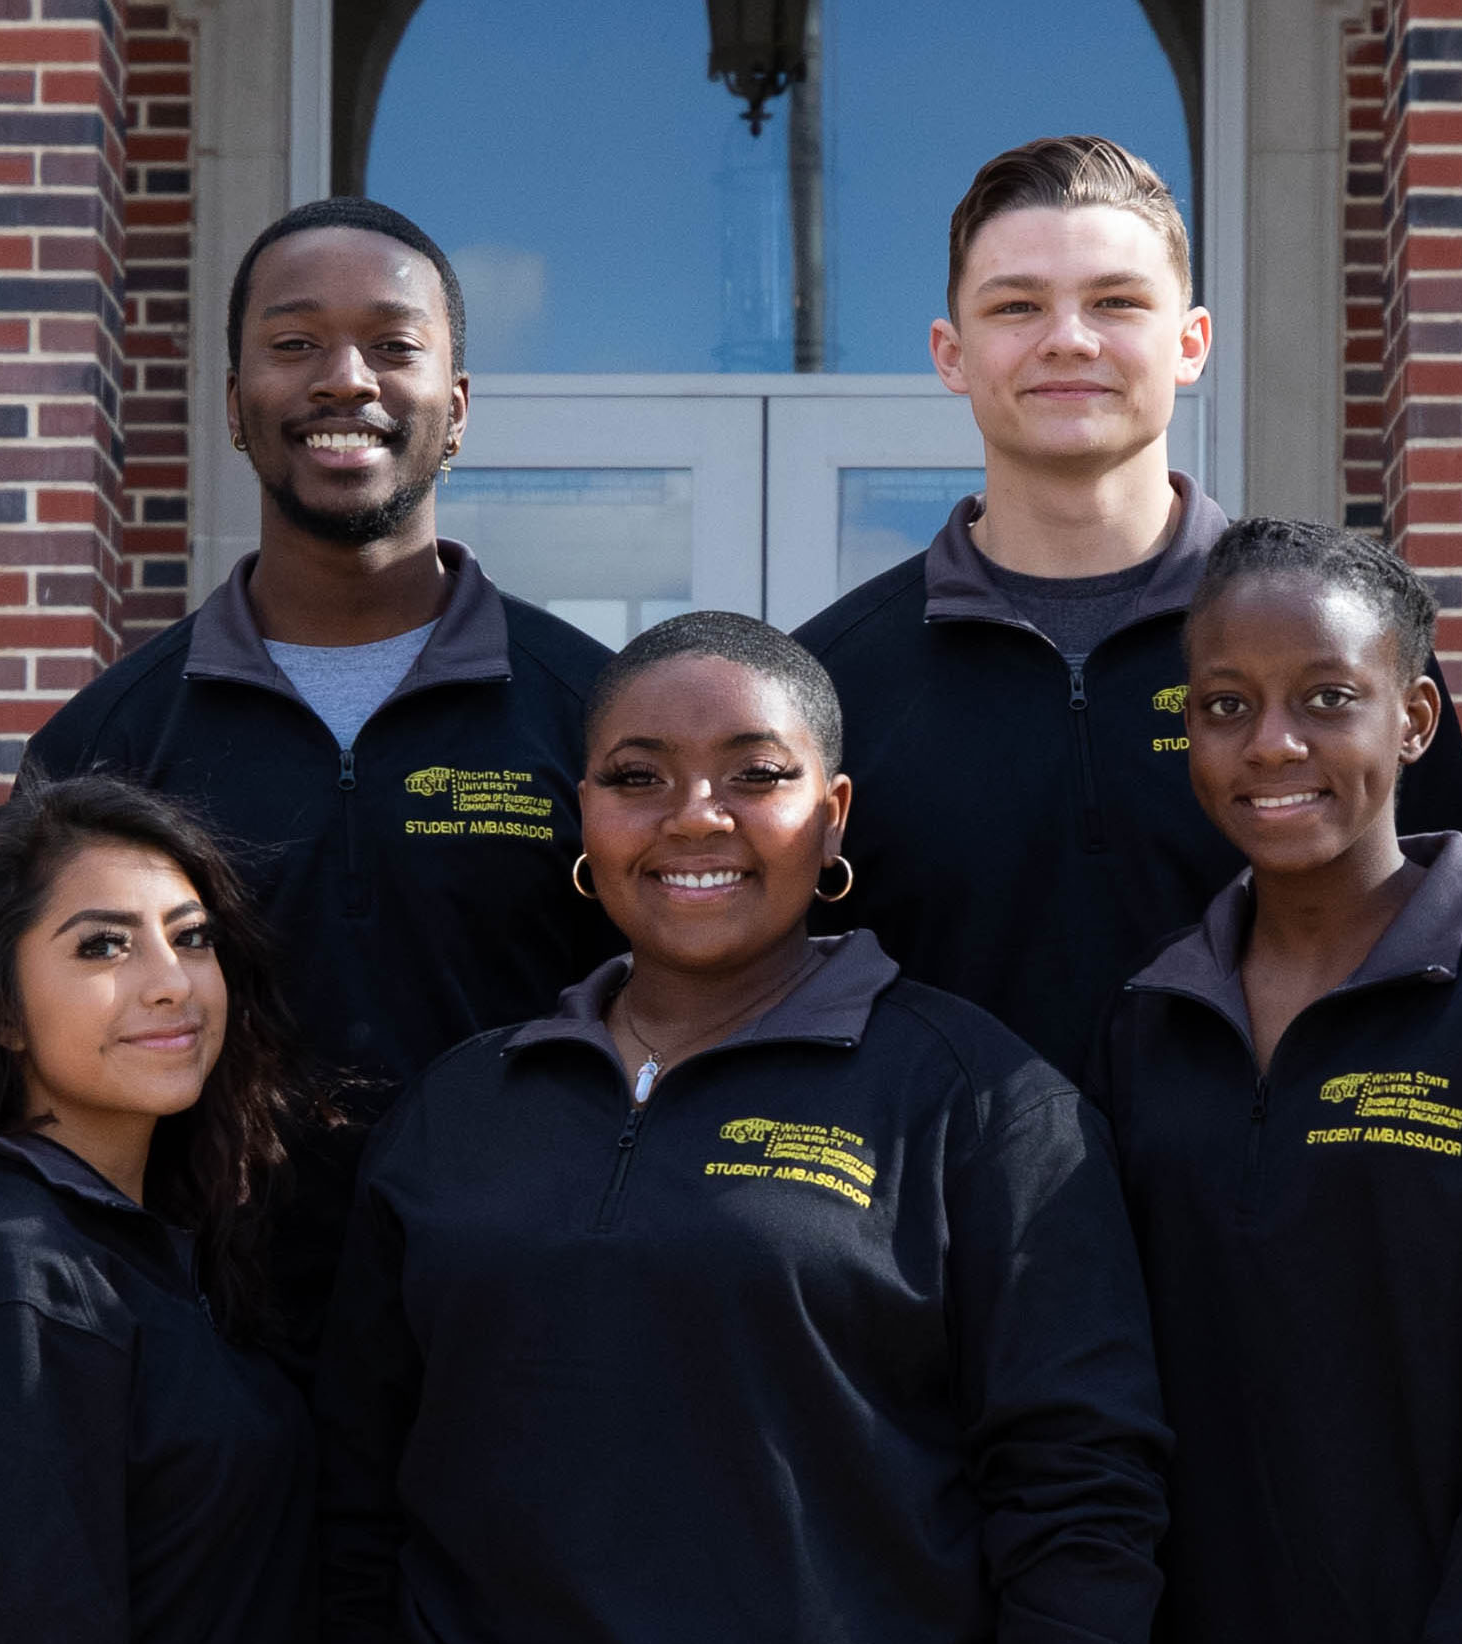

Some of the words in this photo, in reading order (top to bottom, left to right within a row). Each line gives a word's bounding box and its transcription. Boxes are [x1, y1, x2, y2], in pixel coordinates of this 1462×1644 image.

[1153, 738, 1190, 750] STUD
[457, 770, 501, 780] WICHITA
[503, 770, 532, 781] STATE
[457, 780, 518, 791] UNIVERSITY
[405, 820, 466, 833] STUDENT
[469, 820, 554, 839] AMBASSADOR
[1416, 1071, 1450, 1087] STATE
[1368, 1083, 1429, 1095] UNIVERSITY
[777, 1132, 844, 1147] UNIVERSITY
[780, 1122, 827, 1134] WICHITA
[831, 1126, 864, 1145] STATE
[1307, 1128, 1363, 1143] STUDENT
[1364, 1127, 1462, 1156] AMBASSADOR
[705, 1162, 773, 1177] STUDENT
[773, 1166, 871, 1208] AMBASSADOR
